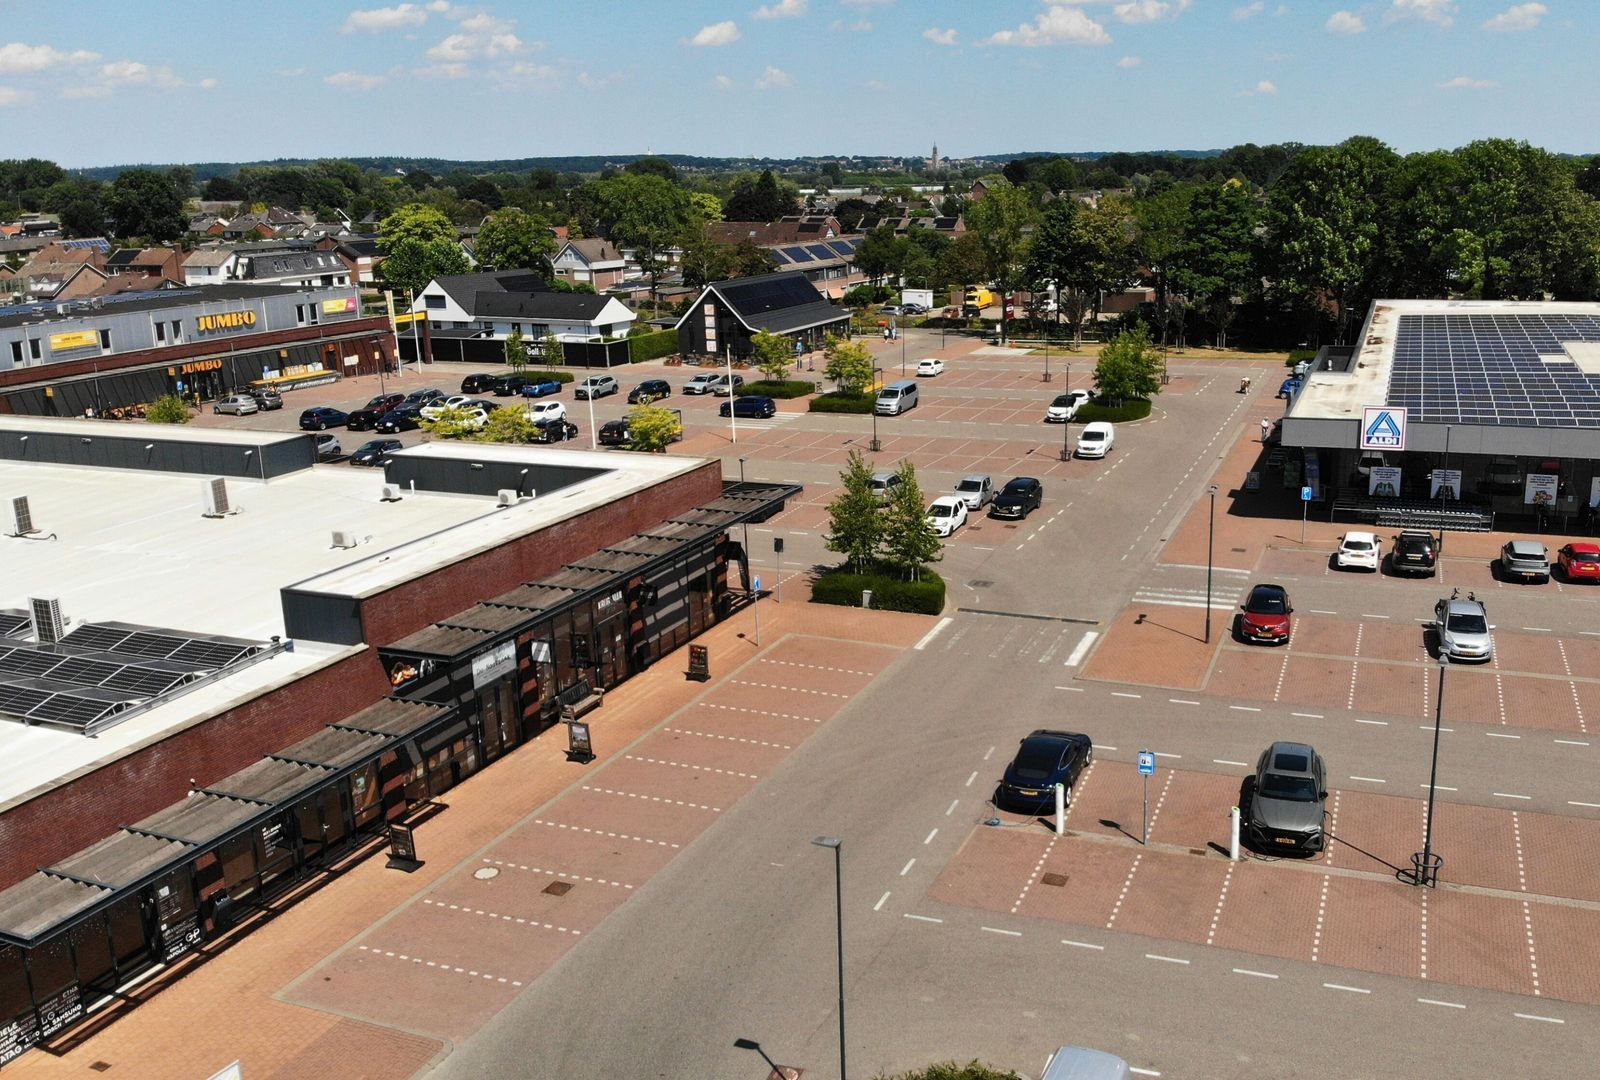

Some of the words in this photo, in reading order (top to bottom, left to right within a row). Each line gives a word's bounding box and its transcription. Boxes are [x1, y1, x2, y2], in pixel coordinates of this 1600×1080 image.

[197, 311, 256, 332] JUMBO
[181, 359, 223, 375] JUMBO
[1369, 436, 1397, 445] ALDI
[186, 928, 200, 942] GP
[41, 1011, 55, 1025] LG
[52, 1004, 82, 1025] SAMSUNG
[0, 1021, 18, 1037] IELE
[43, 1022, 62, 1037] BOSCH
